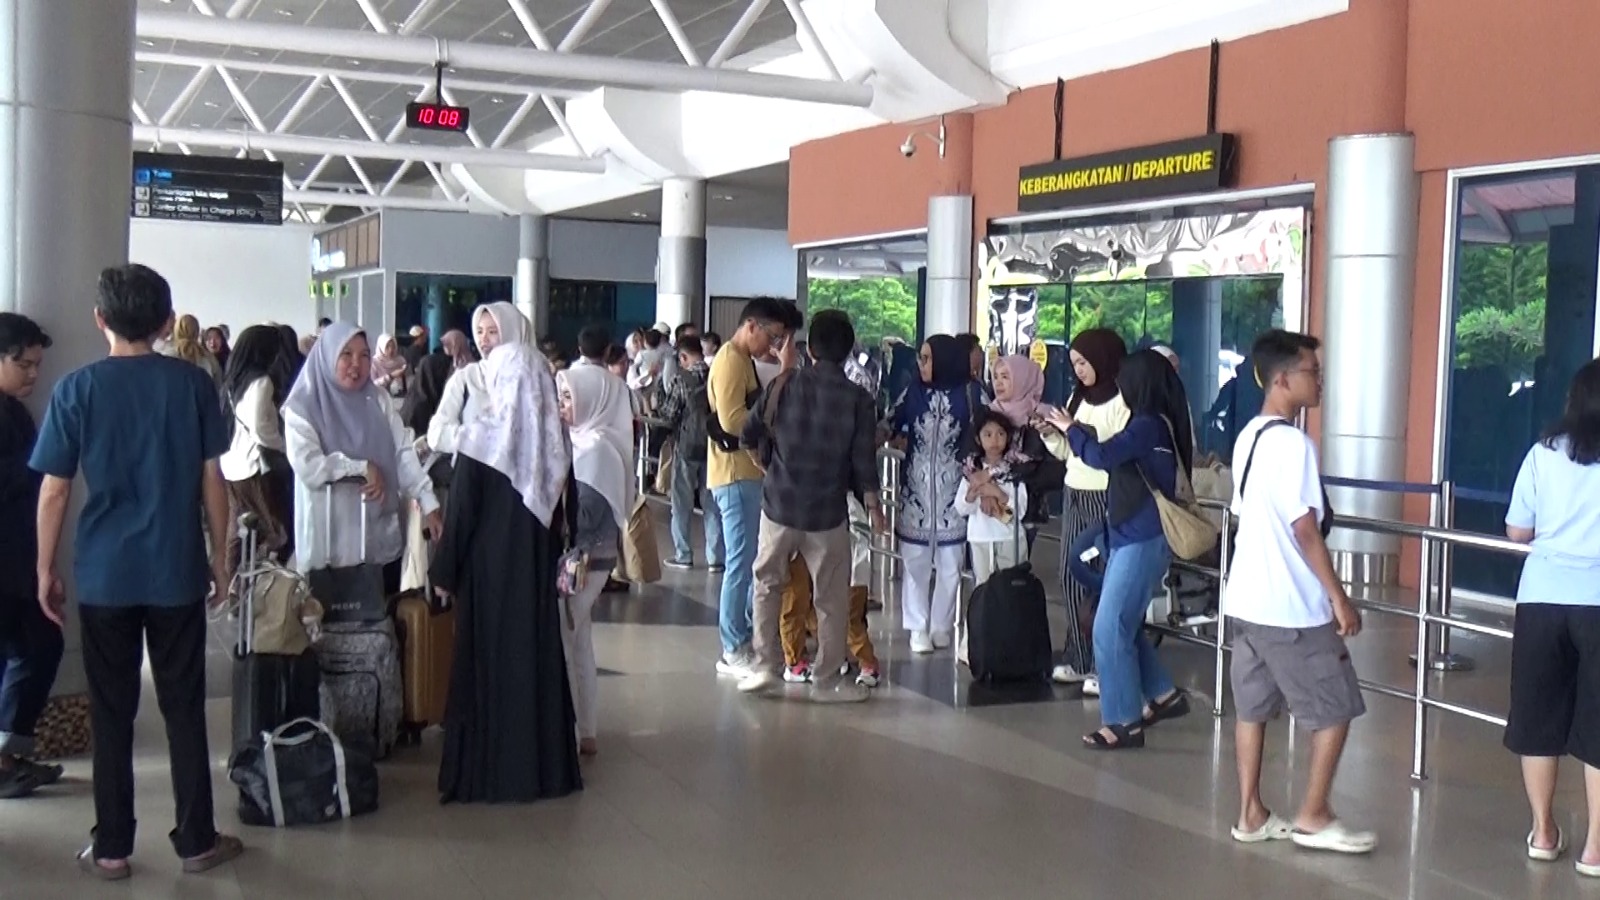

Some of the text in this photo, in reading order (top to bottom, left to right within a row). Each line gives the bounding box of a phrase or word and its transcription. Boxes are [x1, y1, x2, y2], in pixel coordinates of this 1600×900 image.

[418, 108, 459, 126] 10 08
[1019, 165, 1122, 196] KEBERANGKATAN
[1132, 151, 1213, 180] DEPARTURE
